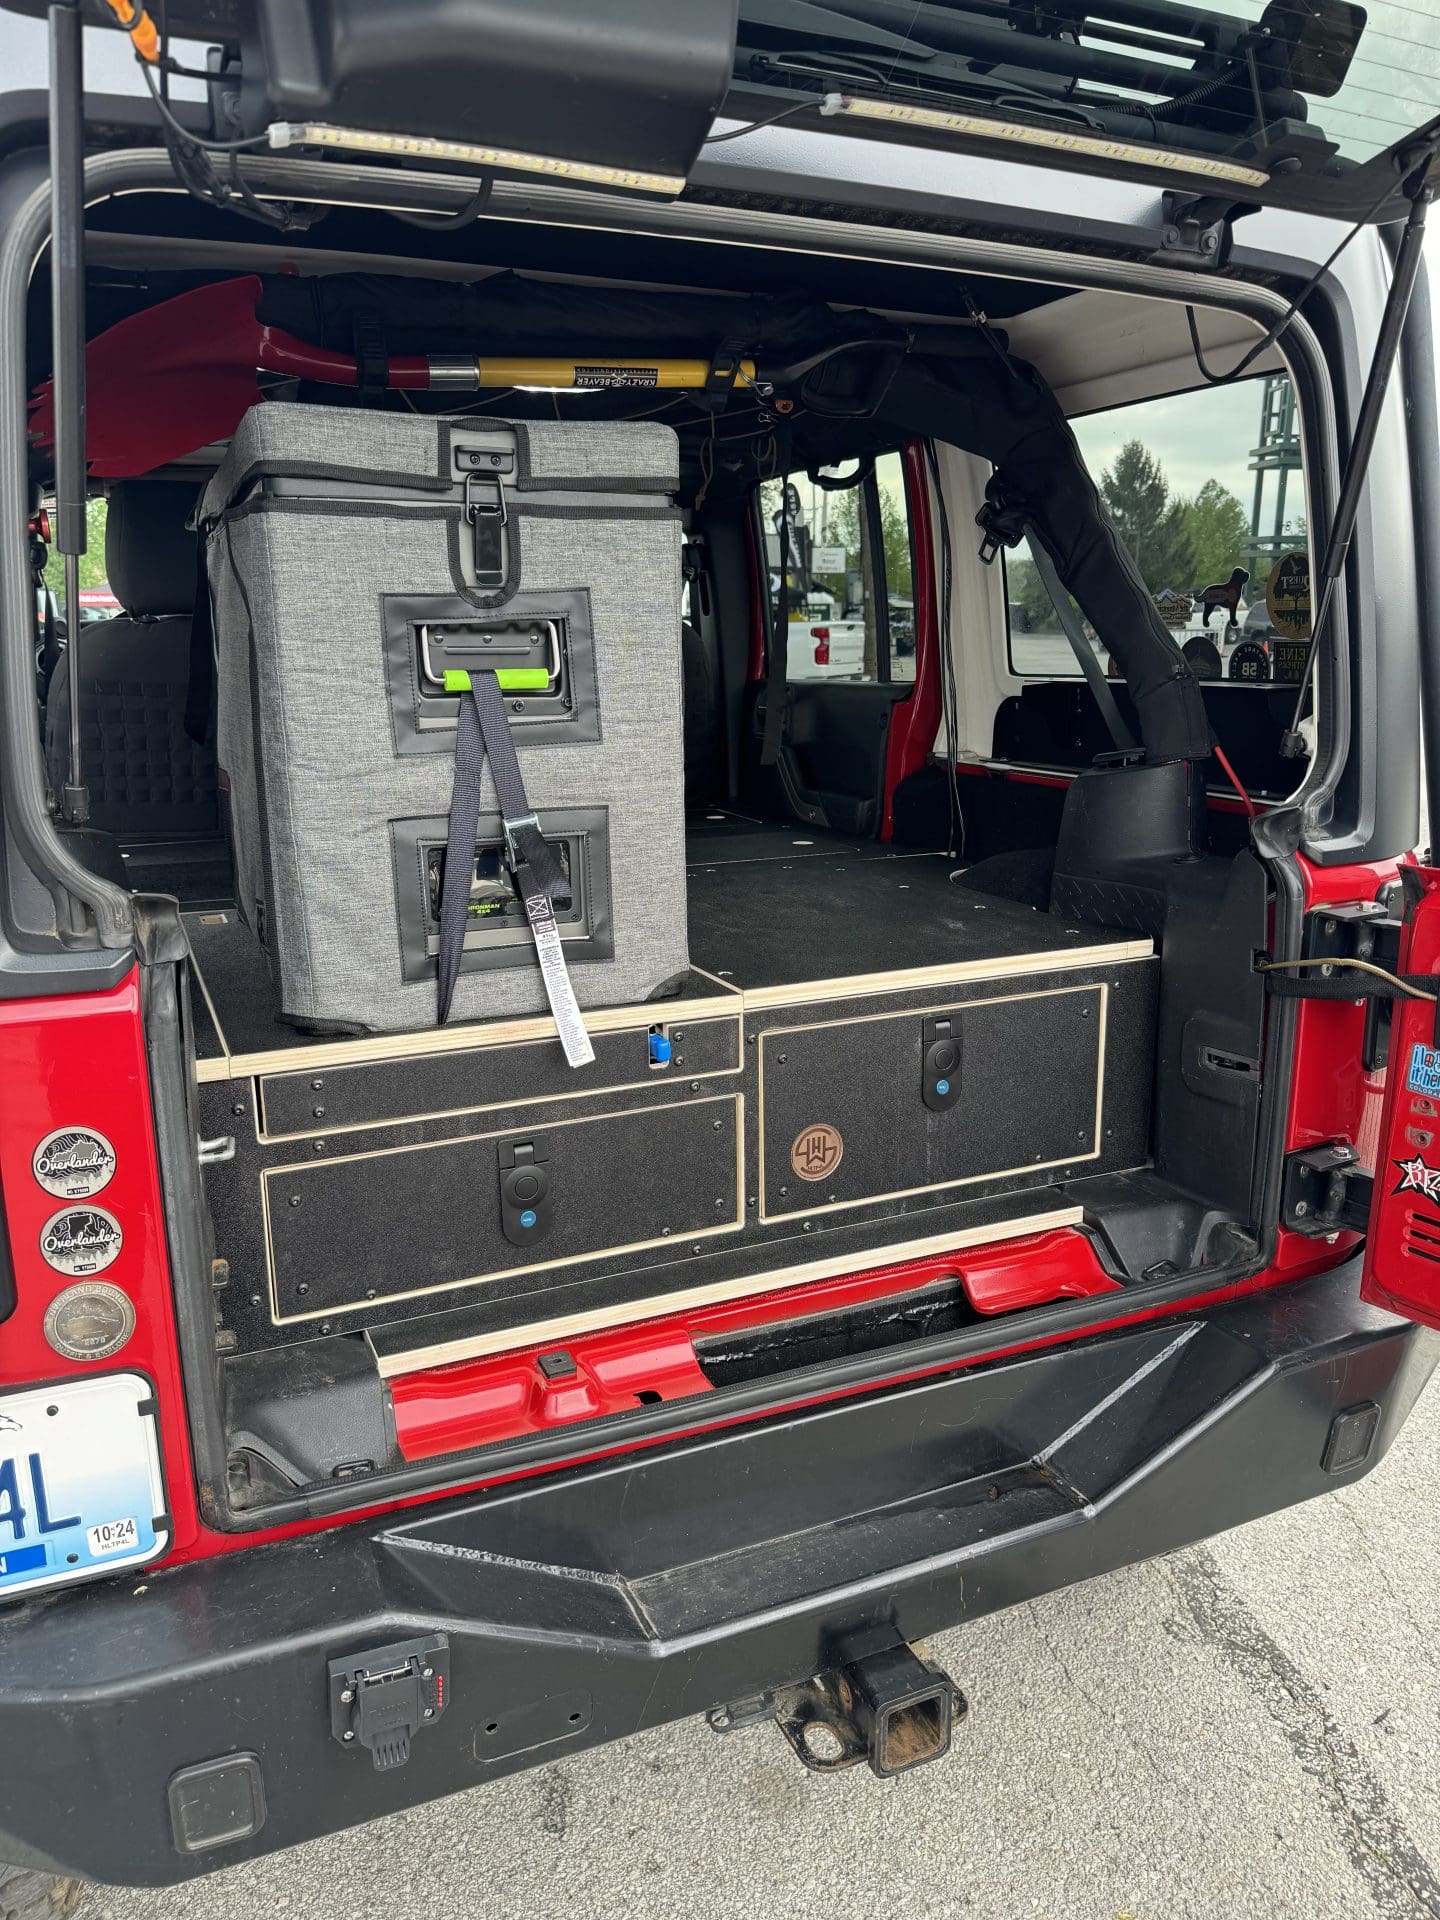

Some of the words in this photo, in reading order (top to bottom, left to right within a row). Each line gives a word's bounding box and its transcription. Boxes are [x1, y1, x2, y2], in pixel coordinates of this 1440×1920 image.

[576, 377, 610, 386] BEAVER
[626, 378, 656, 386] KRAZY
[36, 1150, 114, 1175] Overlander
[44, 1228, 121, 1252] Overlander
[95, 1284, 126, 1305] BOUND
[54, 1342, 83, 1359] OUTFIT
[95, 1332, 130, 1358] EXPLORE
[93, 1525, 111, 1543] 10
[115, 1519, 135, 1538] 24
[101, 1538, 131, 1551] HLTP4L
